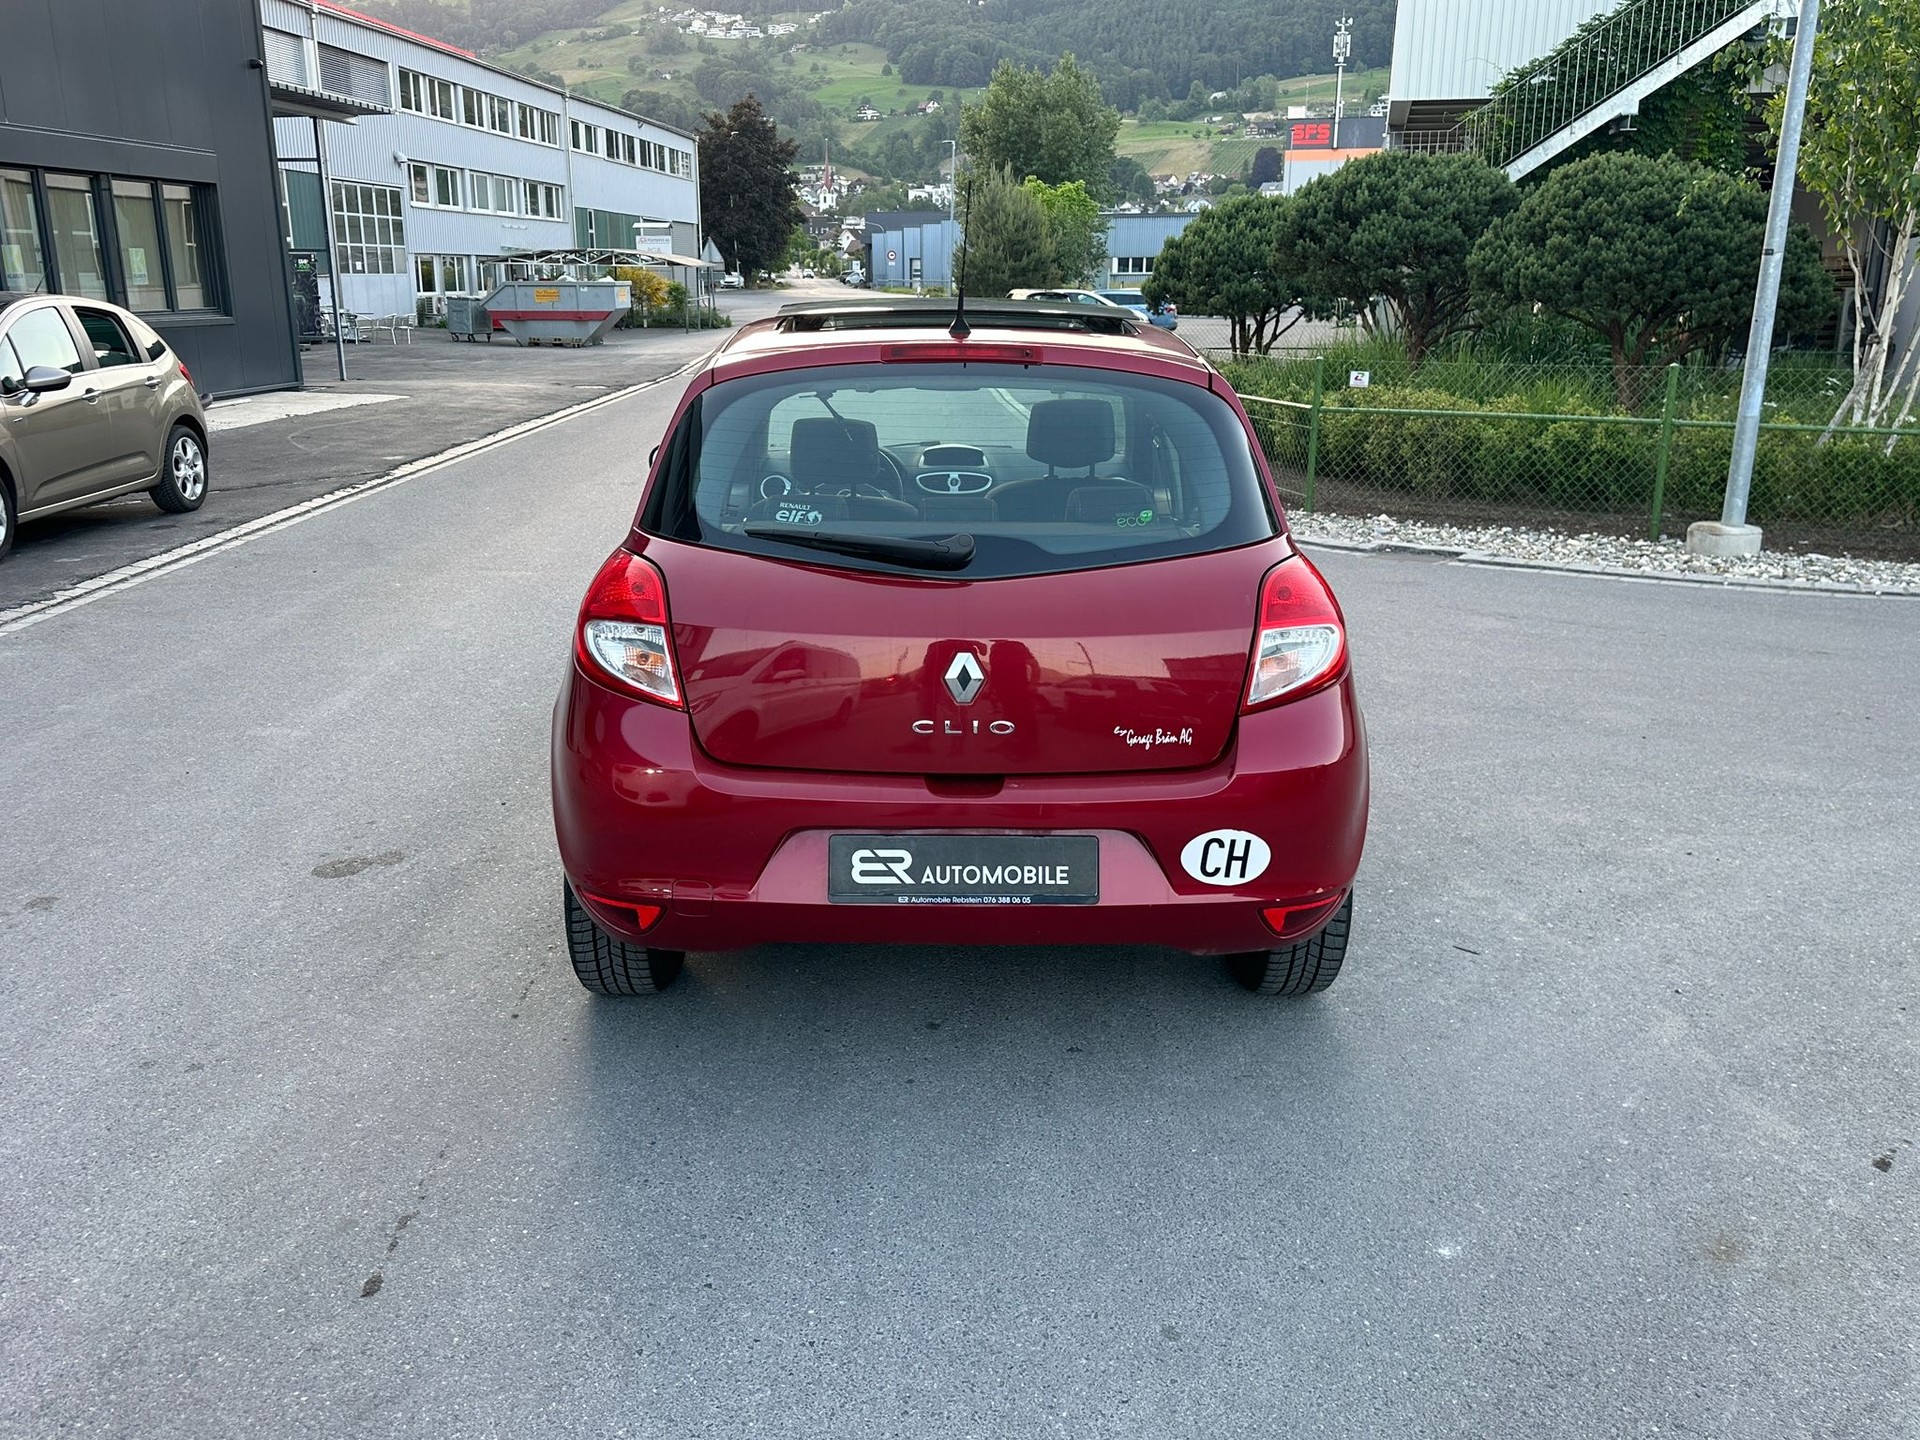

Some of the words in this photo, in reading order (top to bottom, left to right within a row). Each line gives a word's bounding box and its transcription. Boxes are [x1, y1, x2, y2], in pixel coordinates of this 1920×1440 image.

[1292, 123, 1331, 140] SFS
[912, 719, 1015, 735] CLIO
[1126, 729, 1153, 750] Garage
[1179, 727, 1193, 746] AG
[1200, 838, 1252, 879] CH
[921, 865, 1070, 885] AUTOMOBILE
[910, 896, 951, 904] Automobile
[952, 896, 982, 904] Rebstein
[983, 896, 997, 904] 076
[997, 896, 1011, 904] 388
[1011, 896, 1021, 904] 06
[1021, 896, 1031, 904] 05
